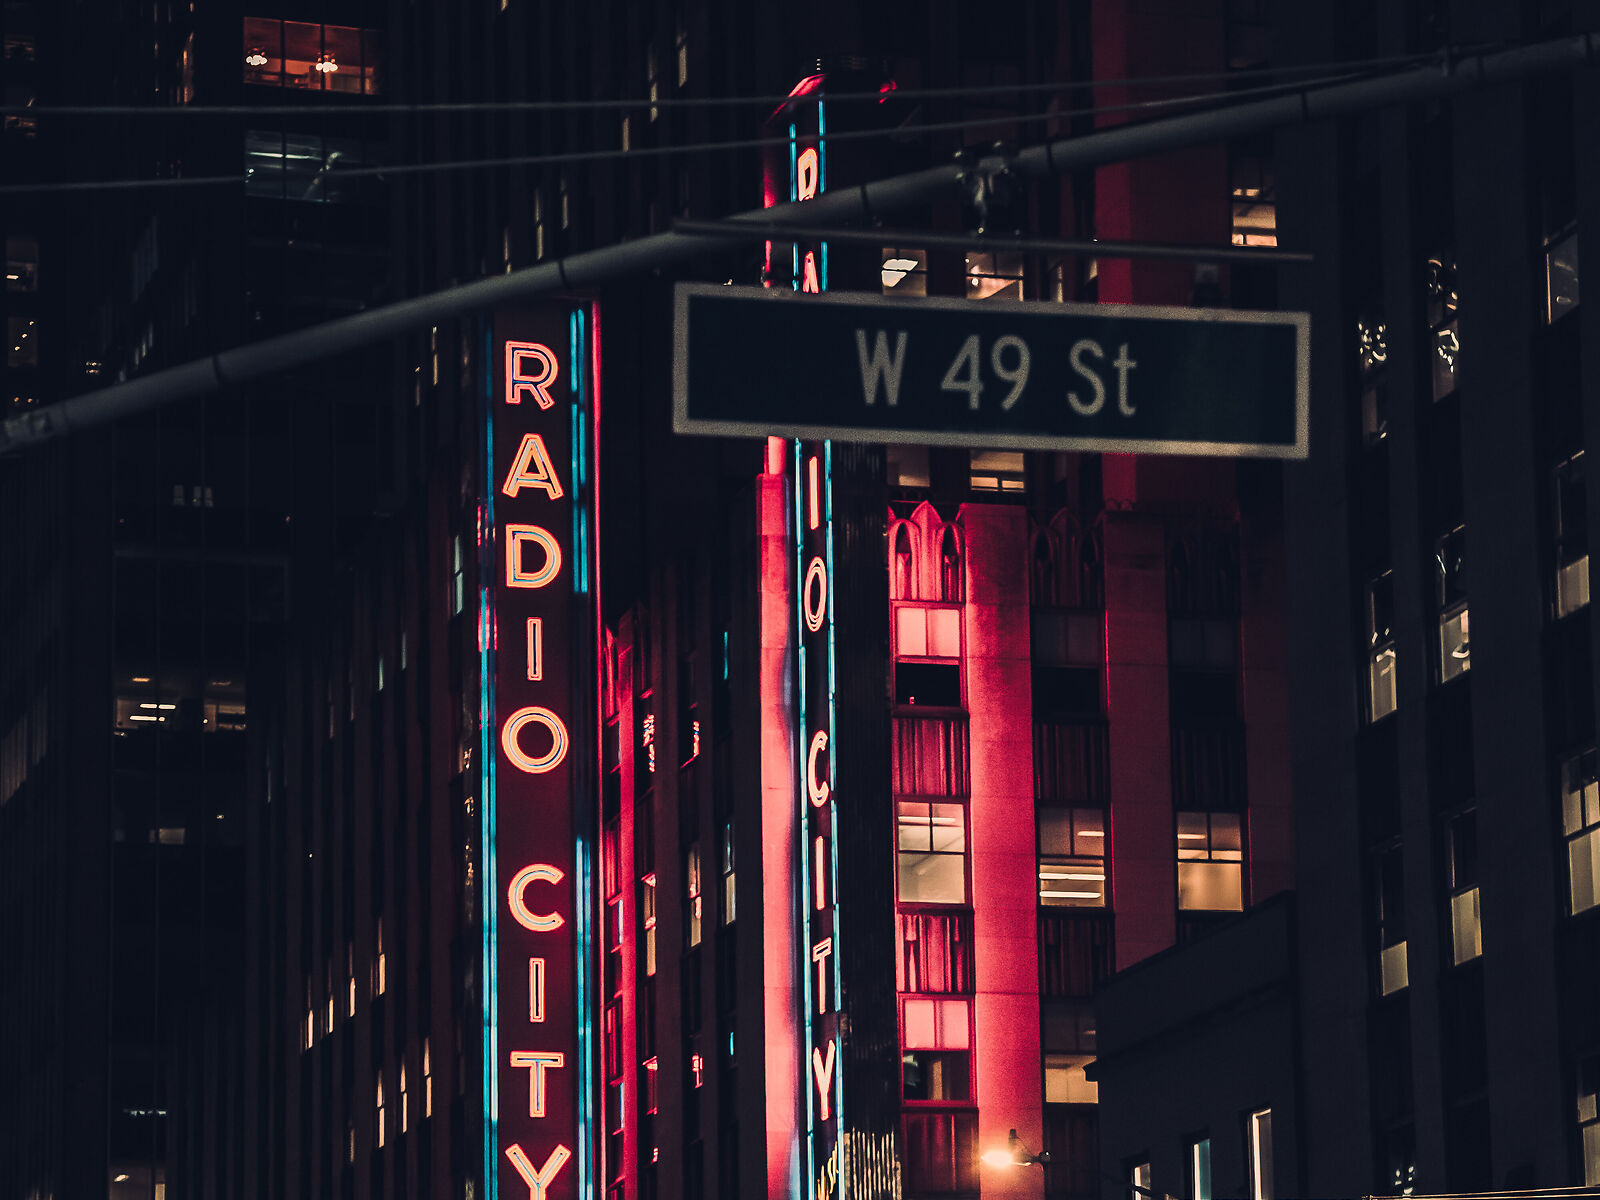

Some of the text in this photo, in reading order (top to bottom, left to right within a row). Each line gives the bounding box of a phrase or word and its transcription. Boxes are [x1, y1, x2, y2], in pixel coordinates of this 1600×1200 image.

[502, 340, 569, 774] RADIO
[855, 328, 1138, 416] W 49 St
[807, 730, 836, 1122] CITY
